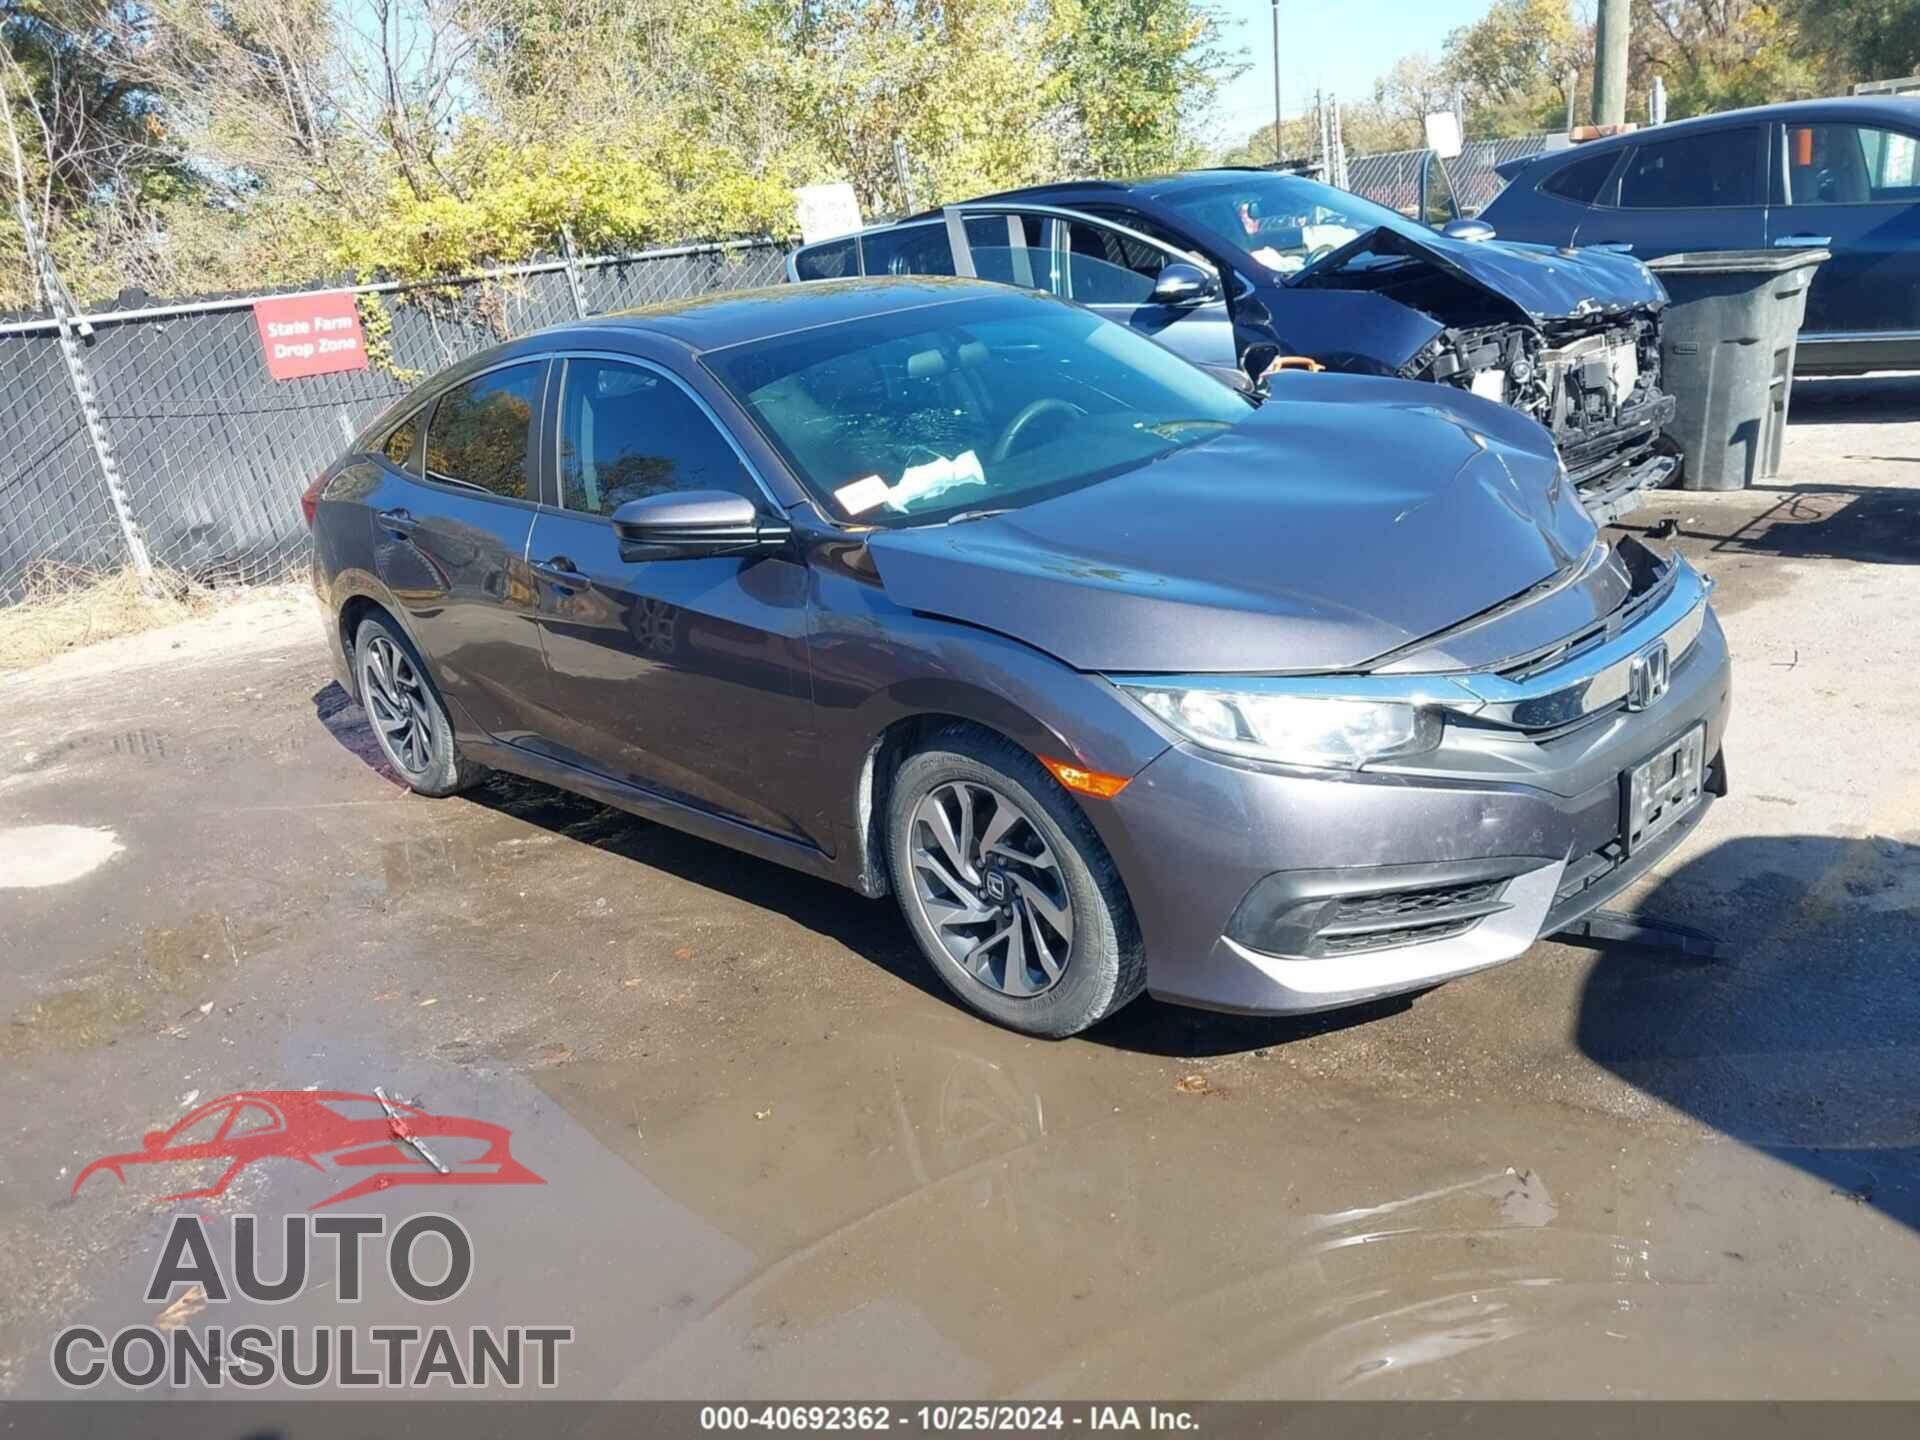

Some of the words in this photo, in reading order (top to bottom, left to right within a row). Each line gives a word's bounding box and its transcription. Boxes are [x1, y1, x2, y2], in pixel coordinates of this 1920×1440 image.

[267, 320, 310, 337] State
[314, 315, 353, 331] Farm
[276, 343, 314, 359] Drop
[319, 337, 356, 352] Zone
